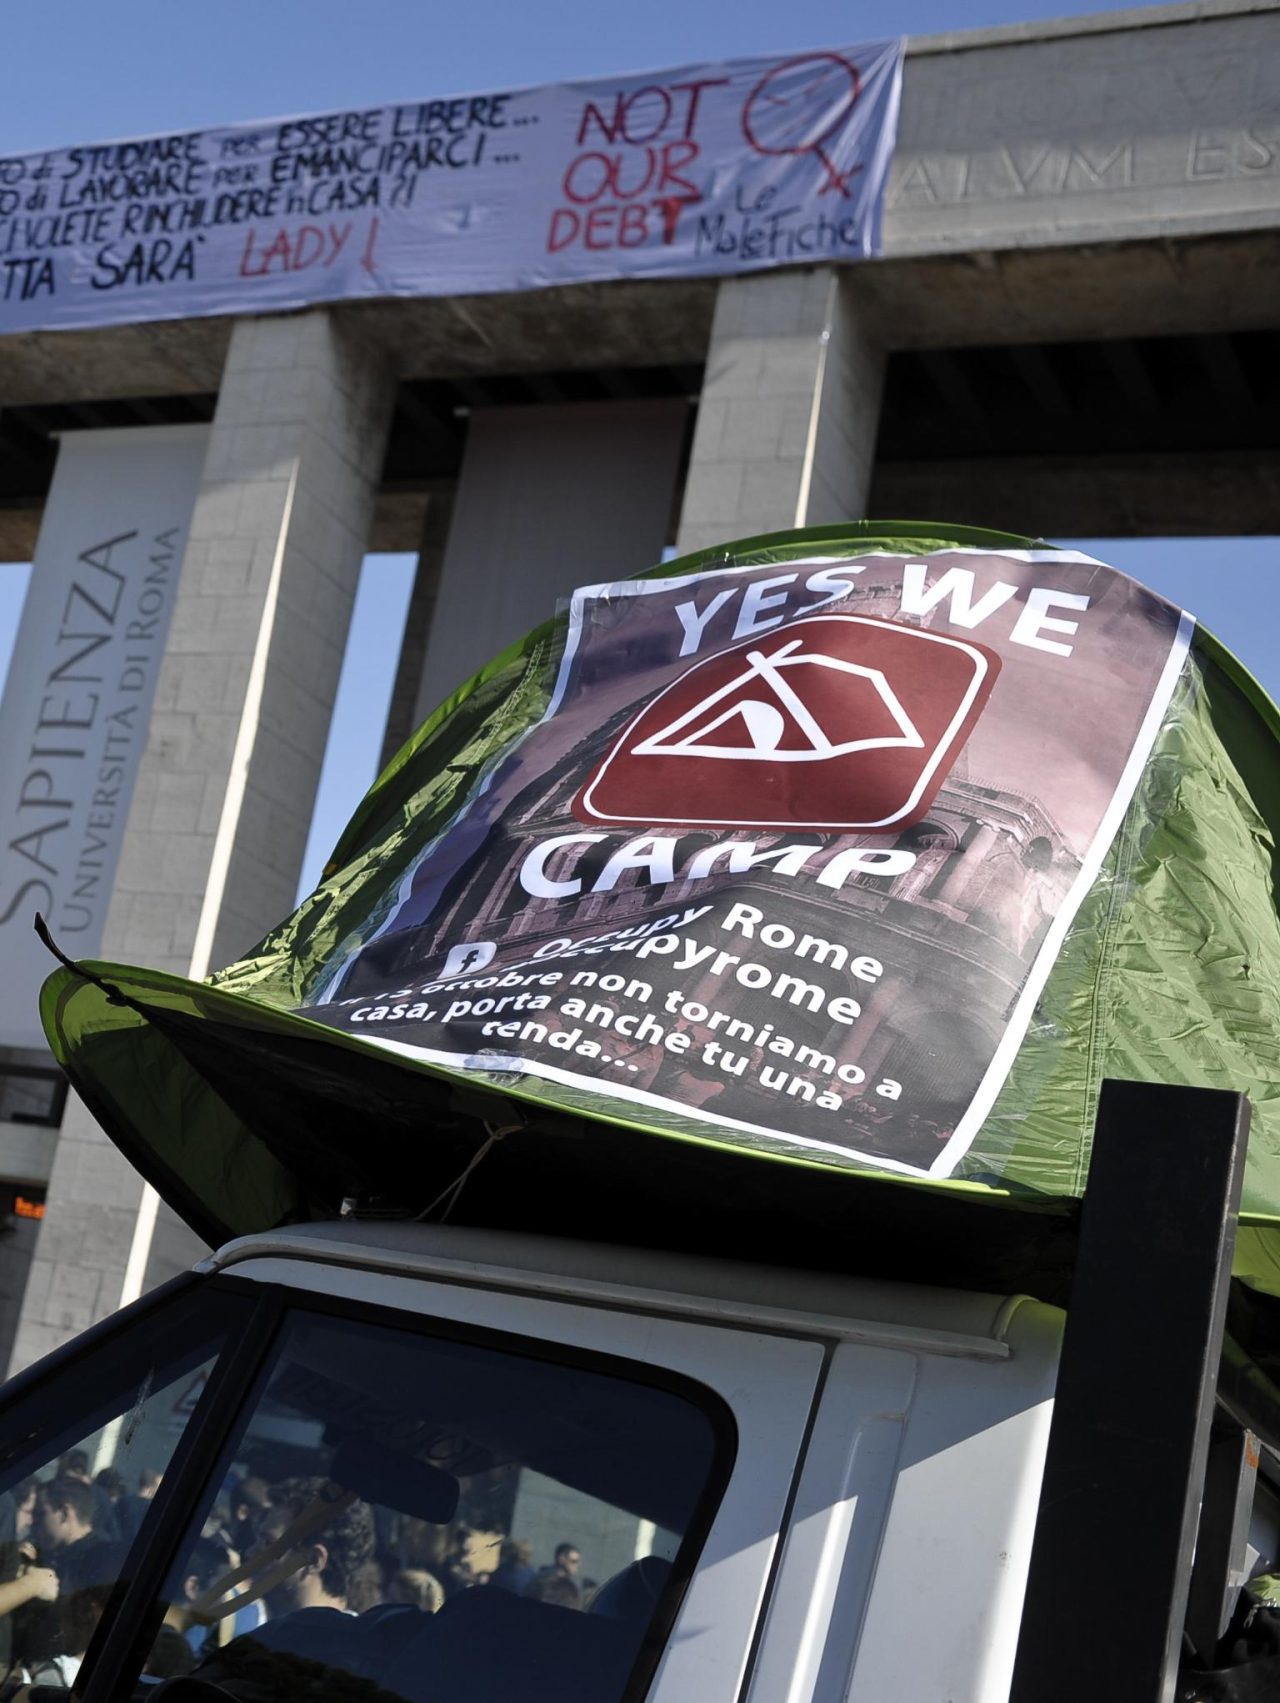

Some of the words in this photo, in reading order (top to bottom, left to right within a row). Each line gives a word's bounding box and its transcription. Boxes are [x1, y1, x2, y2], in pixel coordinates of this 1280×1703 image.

[61, 132, 206, 180] STUDIARE
[277, 110, 383, 151] ESSERE
[577, 78, 730, 146] NOT
[59, 162, 204, 209] LAVORARE
[562, 139, 701, 203] OUR
[546, 194, 703, 254] DEBT
[123, 526, 181, 643] ROMA
[674, 564, 867, 658] YES
[898, 563, 1091, 659] WE
[119, 653, 150, 694] DI
[519, 832, 918, 899] CAMP
[531, 904, 714, 959] Occupy
[721, 902, 884, 984] Rome
[349, 1001, 438, 1022] casa,
[440, 991, 552, 1023] porta
[559, 997, 691, 1055] anche
[701, 1041, 751, 1077] tu
[758, 1064, 844, 1112] una
[570, 970, 653, 1003] non
[664, 989, 866, 1085] torniamo
[875, 1077, 903, 1101] a
